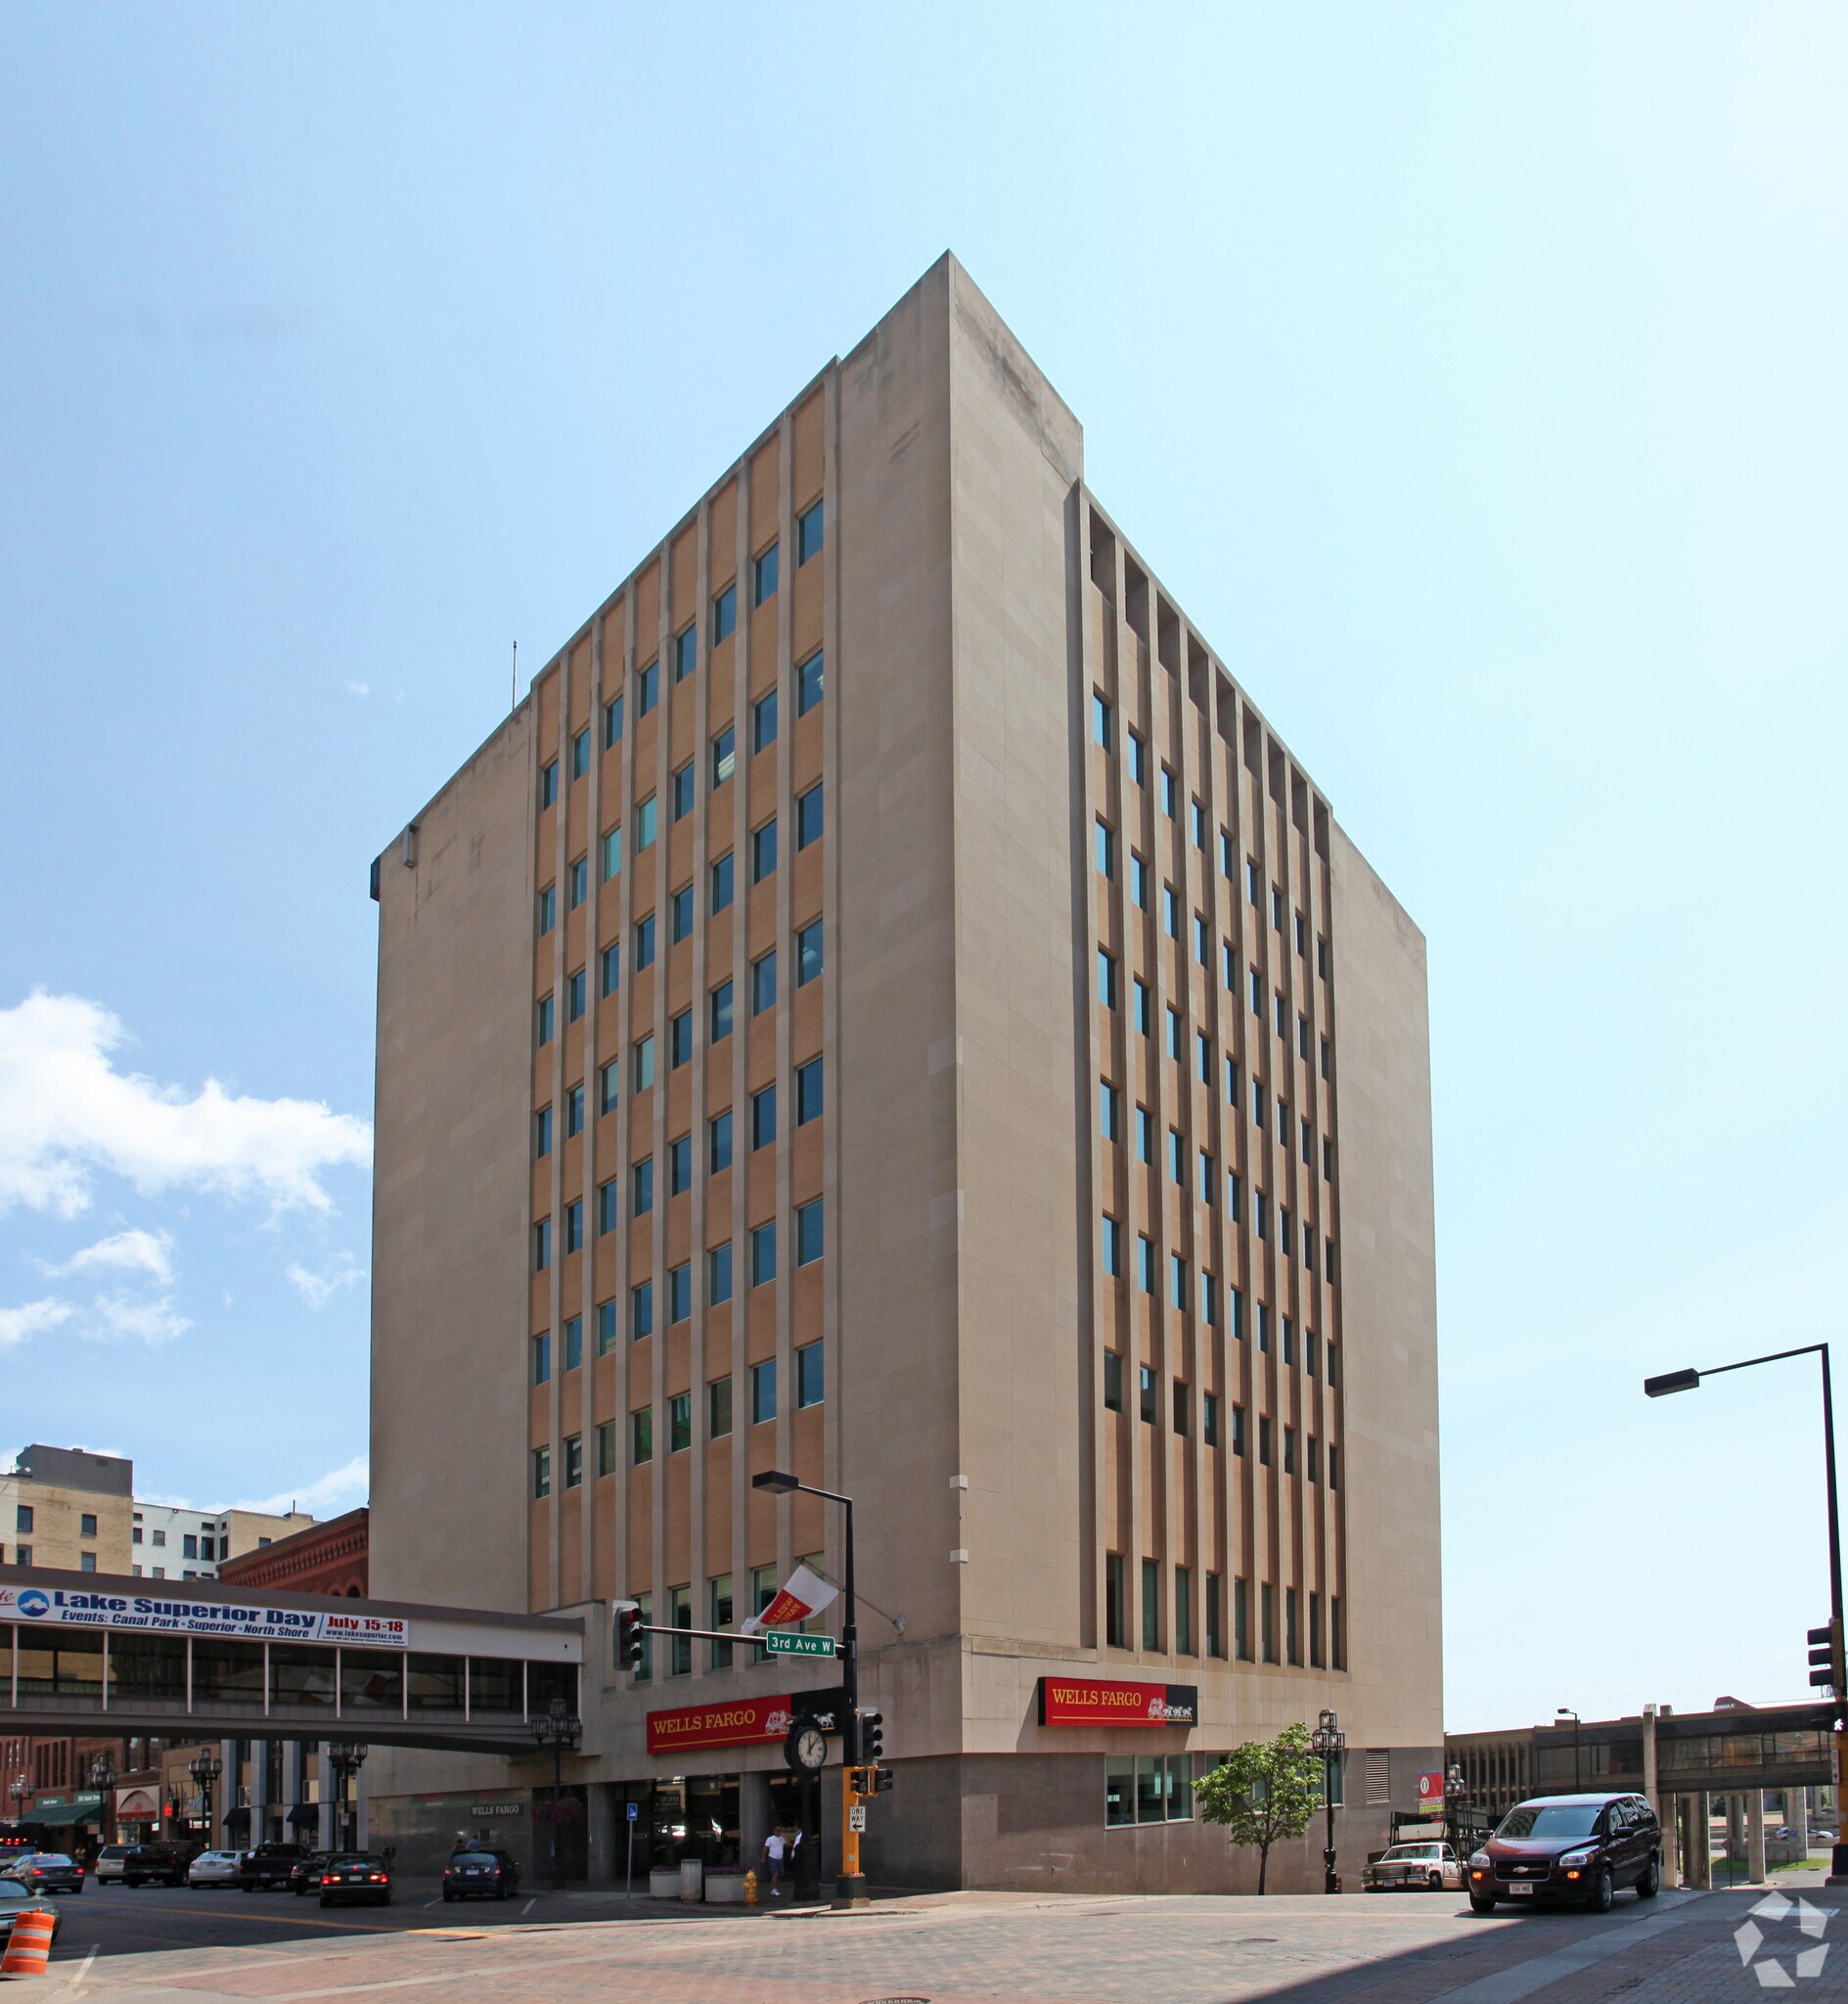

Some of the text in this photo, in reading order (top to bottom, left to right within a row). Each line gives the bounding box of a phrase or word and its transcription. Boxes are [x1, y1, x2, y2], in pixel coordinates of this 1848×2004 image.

[55, 1591, 316, 1628] Lake Superior Day
[61, 1610, 309, 1638] Events: Canal Park Superior North Shore
[327, 1616, 404, 1632] July 15-18
[326, 1629, 403, 1640] www.lakesuperior.com
[772, 1636, 831, 1652] 3rd Ave W
[1053, 1688, 1142, 1707] WELLS FARGO
[654, 1709, 756, 1735] WELLS FARGO
[472, 1804, 519, 1815] WELLS FARGO
